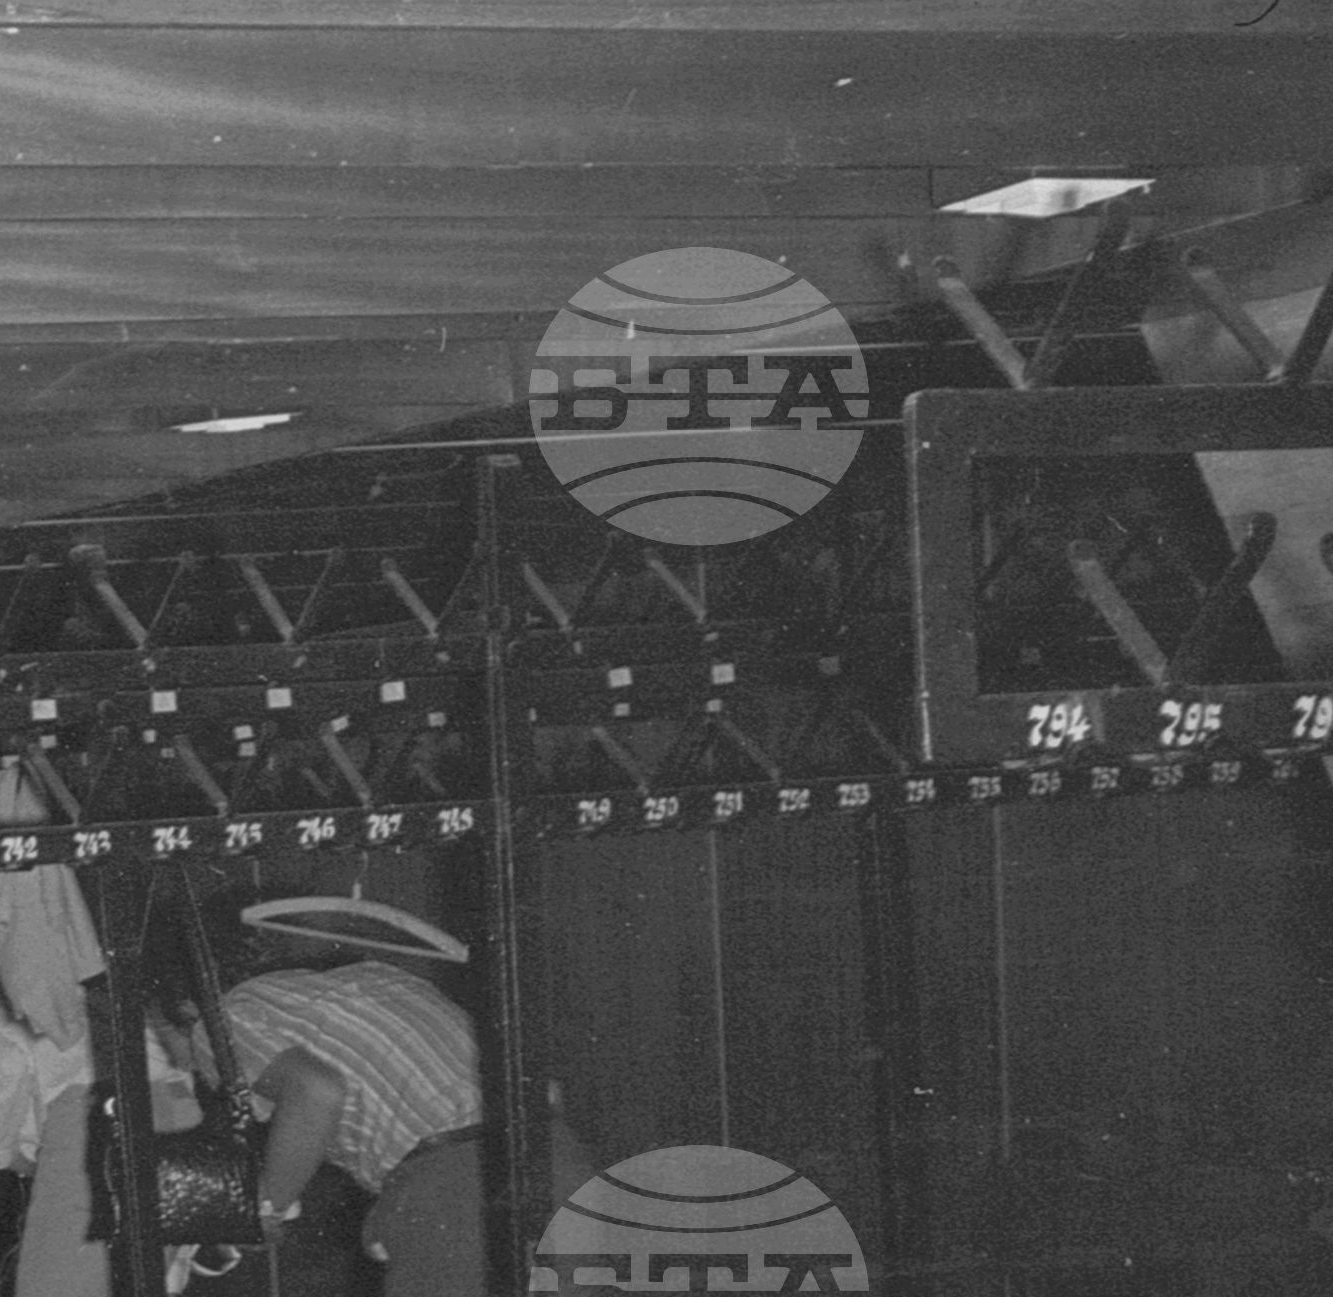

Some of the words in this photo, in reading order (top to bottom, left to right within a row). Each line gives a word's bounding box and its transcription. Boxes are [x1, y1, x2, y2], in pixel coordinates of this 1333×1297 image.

[1028, 703, 1091, 748] 794
[1160, 700, 1223, 746] 795
[1, 836, 38, 862] 742
[74, 830, 111, 858] 743
[153, 826, 192, 851] 744
[225, 823, 263, 847] 745
[297, 817, 335, 844] 746
[367, 813, 403, 839] 747
